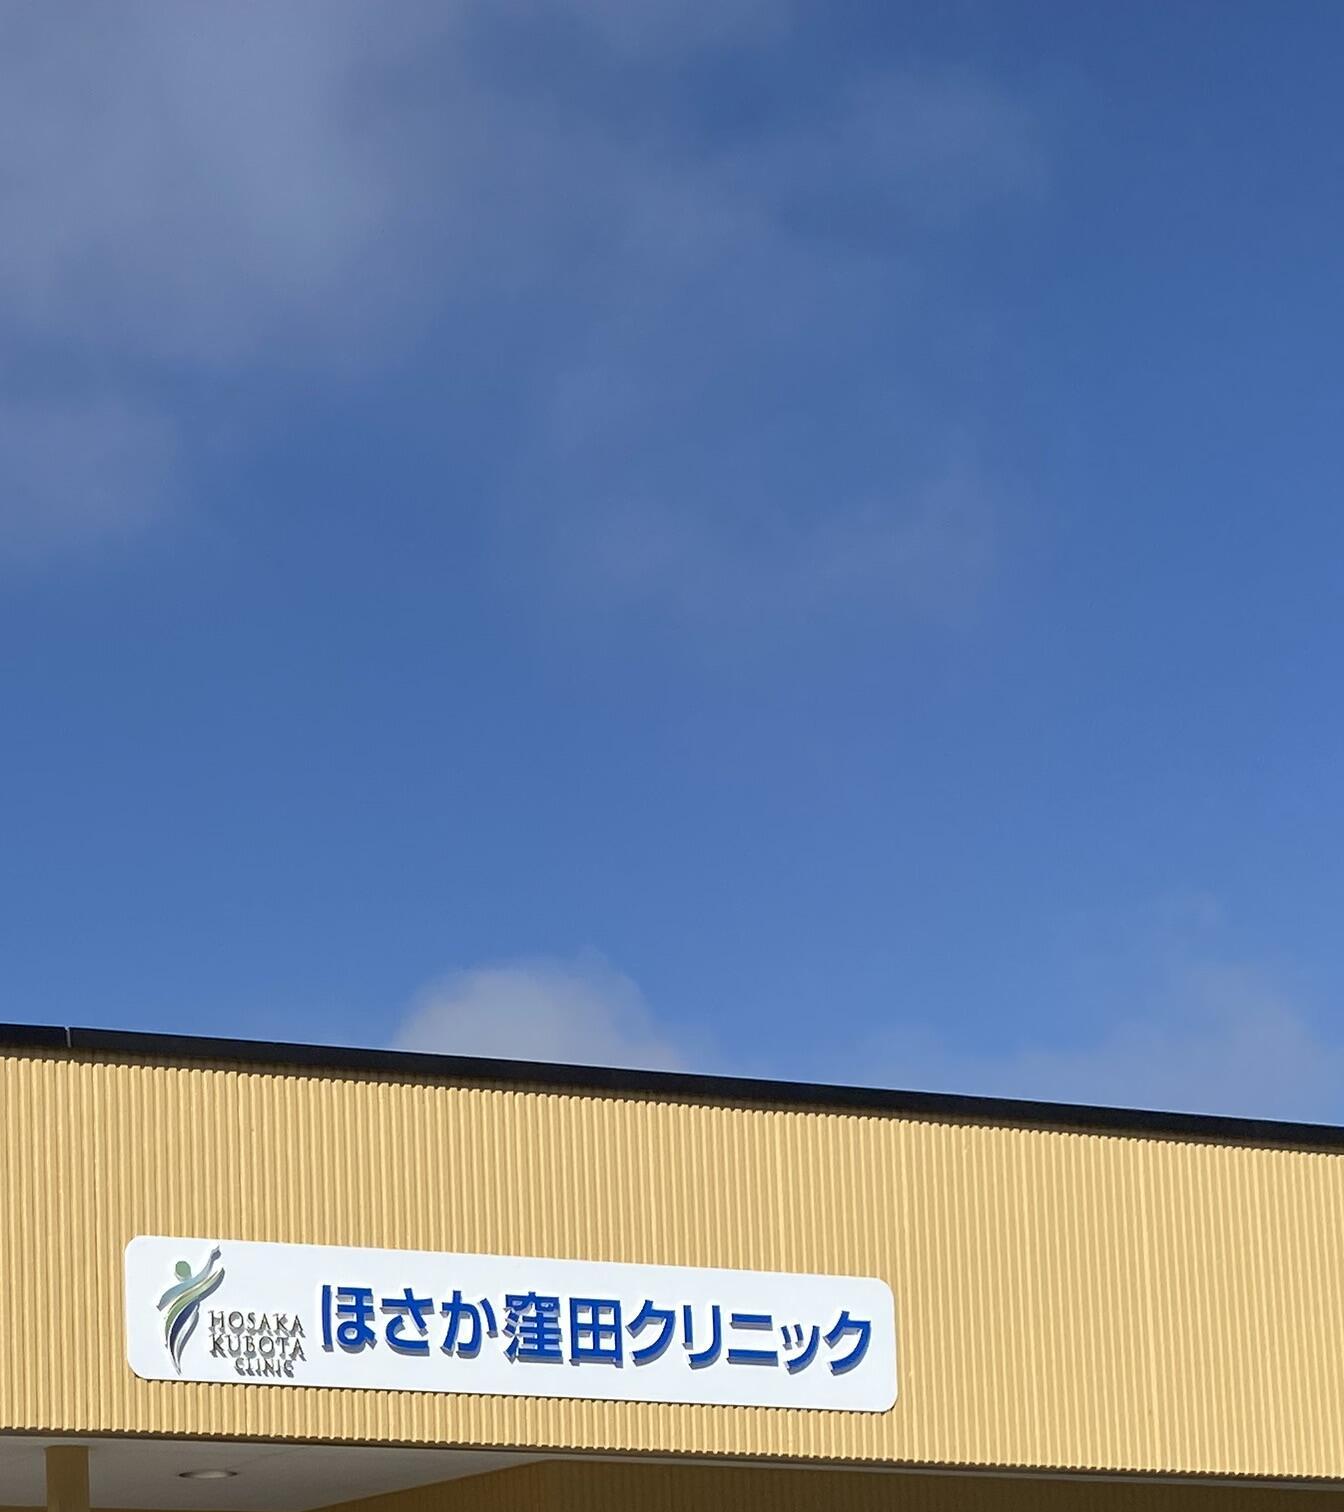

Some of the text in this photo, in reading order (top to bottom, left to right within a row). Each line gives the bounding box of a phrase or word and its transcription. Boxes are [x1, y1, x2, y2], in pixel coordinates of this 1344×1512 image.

[208, 1310, 305, 1337] HOSAKA
[320, 1284, 872, 1375] ほさか窪田クリニック
[209, 1334, 306, 1360] KUBOTA
